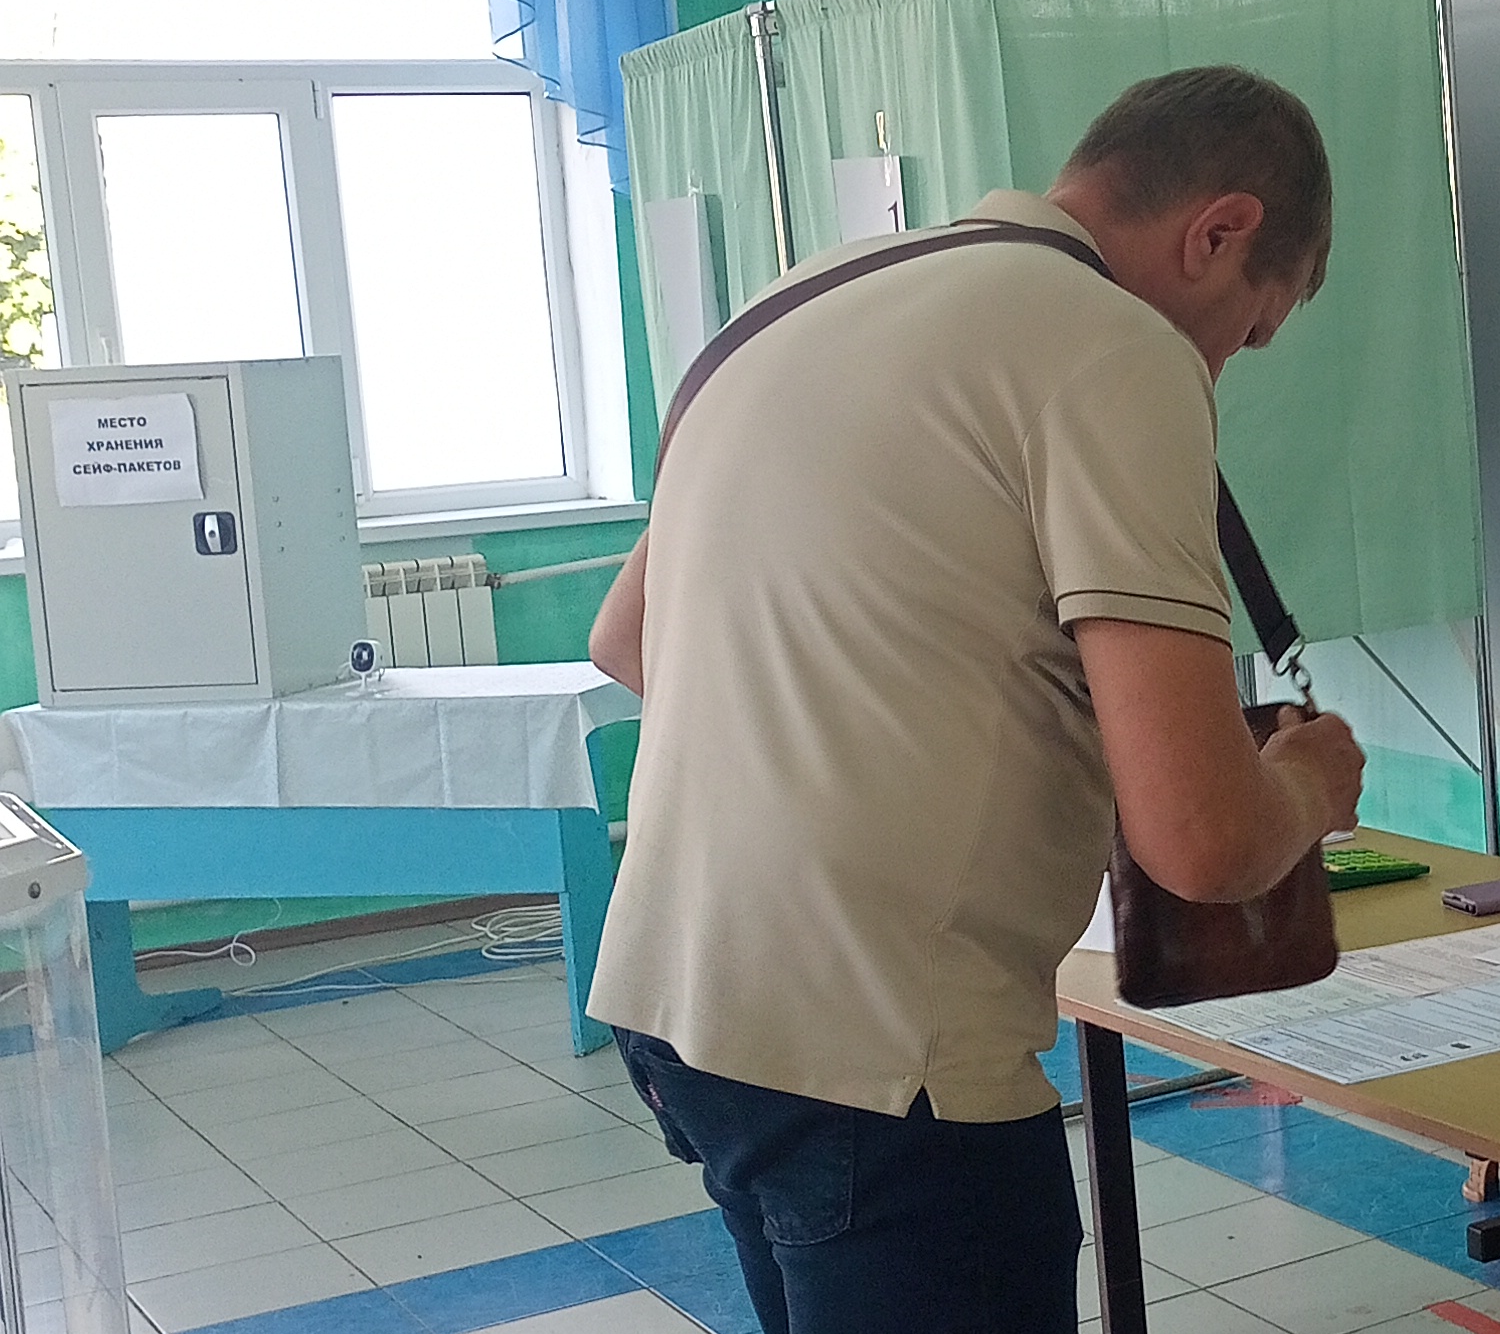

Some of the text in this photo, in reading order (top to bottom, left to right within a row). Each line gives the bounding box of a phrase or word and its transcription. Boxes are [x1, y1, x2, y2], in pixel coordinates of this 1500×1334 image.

[97, 416, 147, 429] МЕСТО
[86, 438, 164, 452] ХРАНЕНИЯ
[72, 460, 182, 475] СЕЙФ-ПАКЕТОВ
